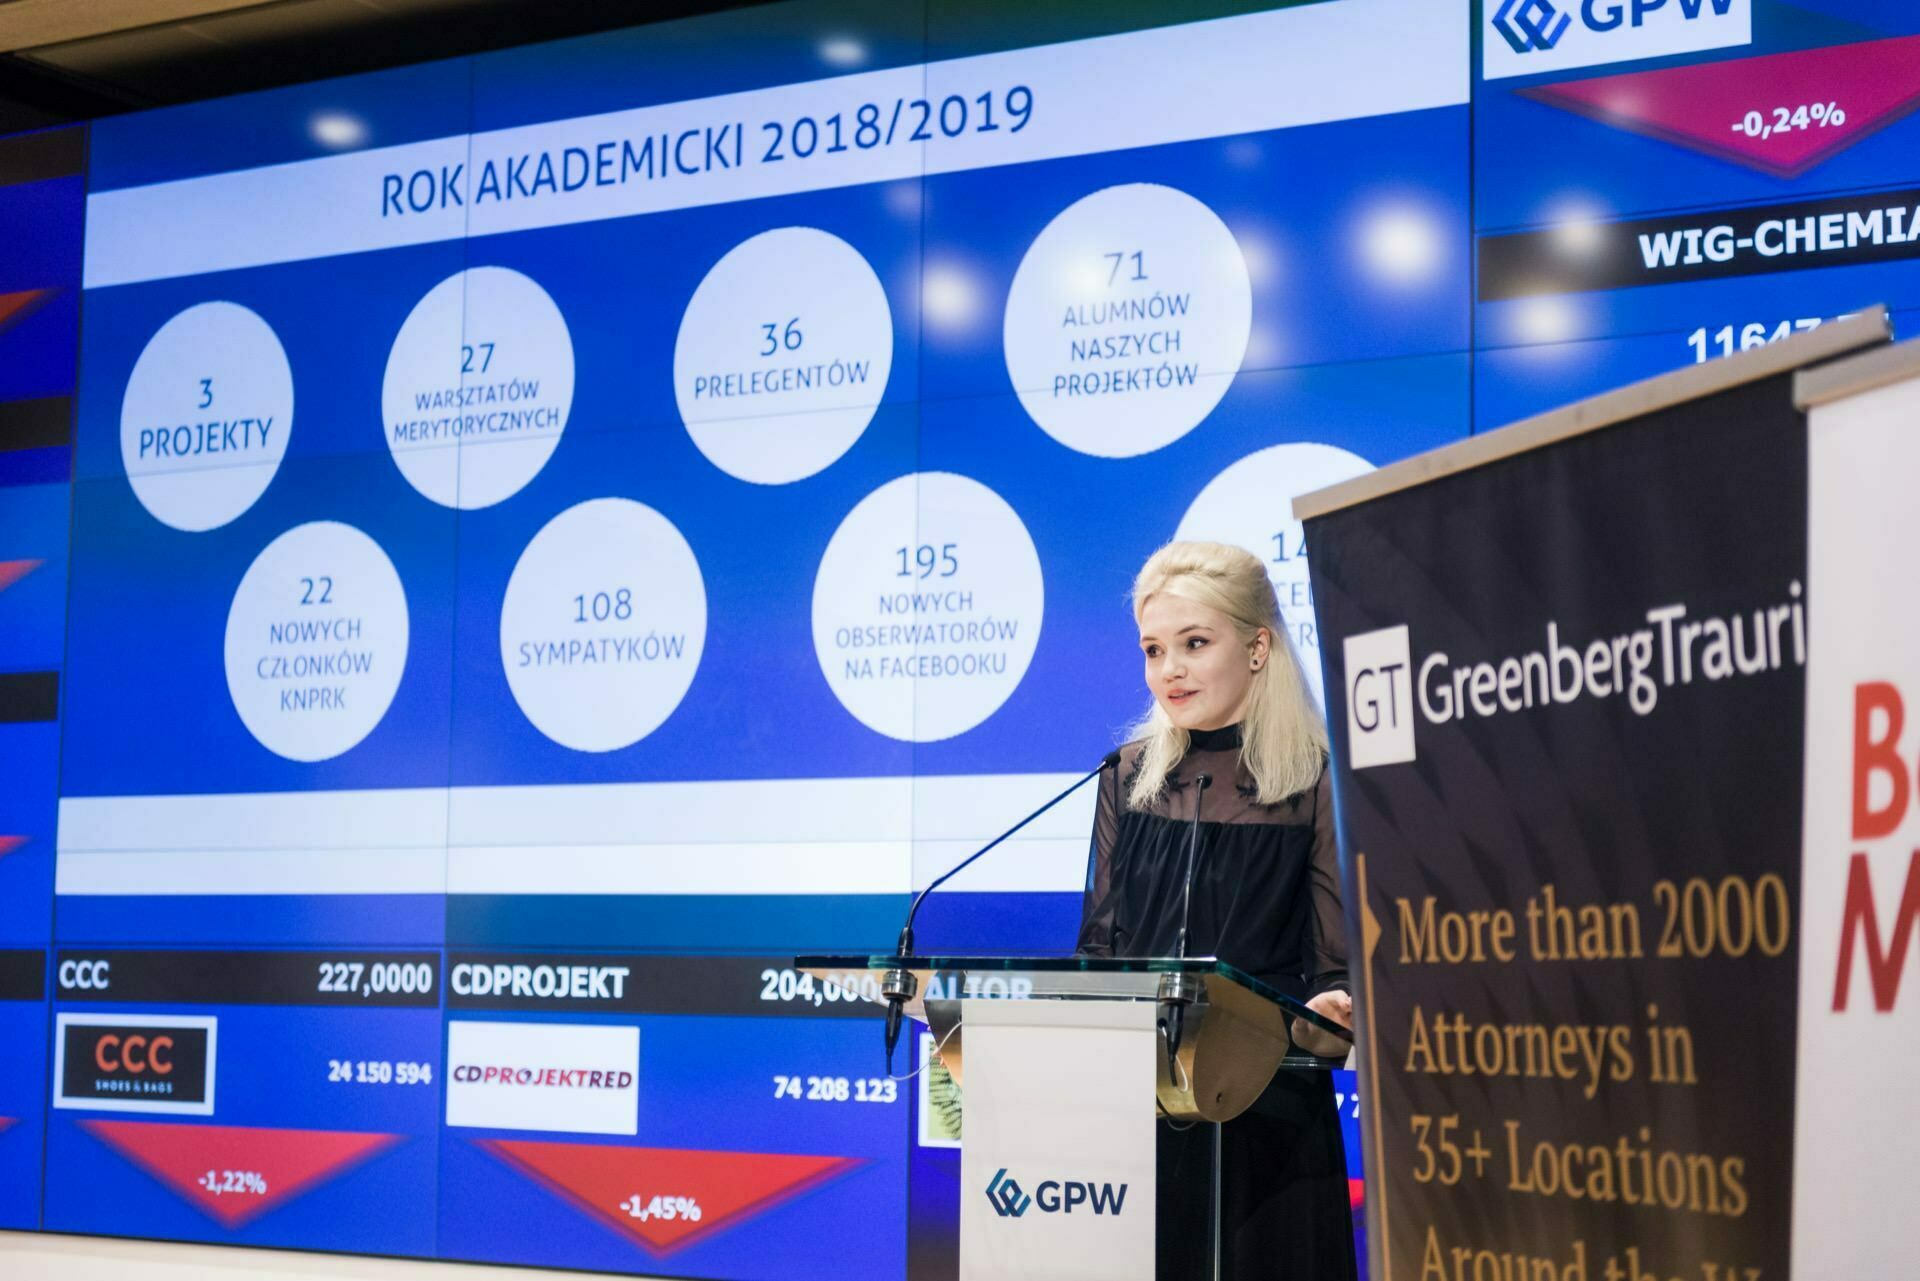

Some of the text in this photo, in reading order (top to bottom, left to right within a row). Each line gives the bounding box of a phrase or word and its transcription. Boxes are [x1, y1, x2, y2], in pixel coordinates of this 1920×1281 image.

[1732, 102, 1846, 139] -0,24%
[382, 85, 1034, 216] ROK AKADEMICKI 2018/2019
[1104, 250, 1149, 285] 71
[1063, 292, 1191, 328] ALUMNÓW
[760, 318, 803, 356] 36
[1071, 331, 1180, 361] NASZYCH
[461, 343, 495, 374] 27
[198, 379, 213, 408] 3
[415, 380, 540, 412] WARSZTATÓW
[694, 359, 870, 399] PRELEGENTÓW
[1053, 363, 1198, 398] PROJEKTÓW
[139, 417, 273, 459] PROJEKTY
[394, 406, 560, 443] MERYTORYCZNYCH
[895, 543, 958, 580] 195
[300, 577, 333, 605] 22
[573, 588, 632, 623] 108
[879, 591, 973, 614] NOWYCH
[270, 619, 361, 644] NOWYCH
[836, 619, 1018, 649] OBSERWATORÓW
[257, 651, 373, 680] CZŁONKÓW
[519, 631, 685, 668] SYMPATYKÓW
[845, 653, 1006, 679] NA FACEBOOKU
[280, 688, 345, 712] KNPRK
[1353, 663, 1404, 733] GT
[1851, 680, 1920, 842] B
[1398, 873, 1790, 964] More than 2000
[59, 961, 109, 990] CCC
[318, 963, 432, 998] 227,0000
[451, 963, 630, 999] CDPROJEKT
[760, 968, 887, 1008] 204,000
[95, 1034, 173, 1074] CCC
[1405, 1004, 1697, 1099] Attorneys in
[96, 1079, 130, 1092] SHOES
[144, 1081, 173, 1094] BAGS
[328, 1060, 433, 1085] 24 150 594
[774, 1076, 898, 1103] 74 208 123
[198, 1171, 267, 1195] -1,22%
[1410, 1114, 1748, 1217] 35+ Locations
[620, 1195, 702, 1223] -1,45%
[1035, 1180, 1129, 1216] GPW
[1419, 1225, 1588, 1281] Around
